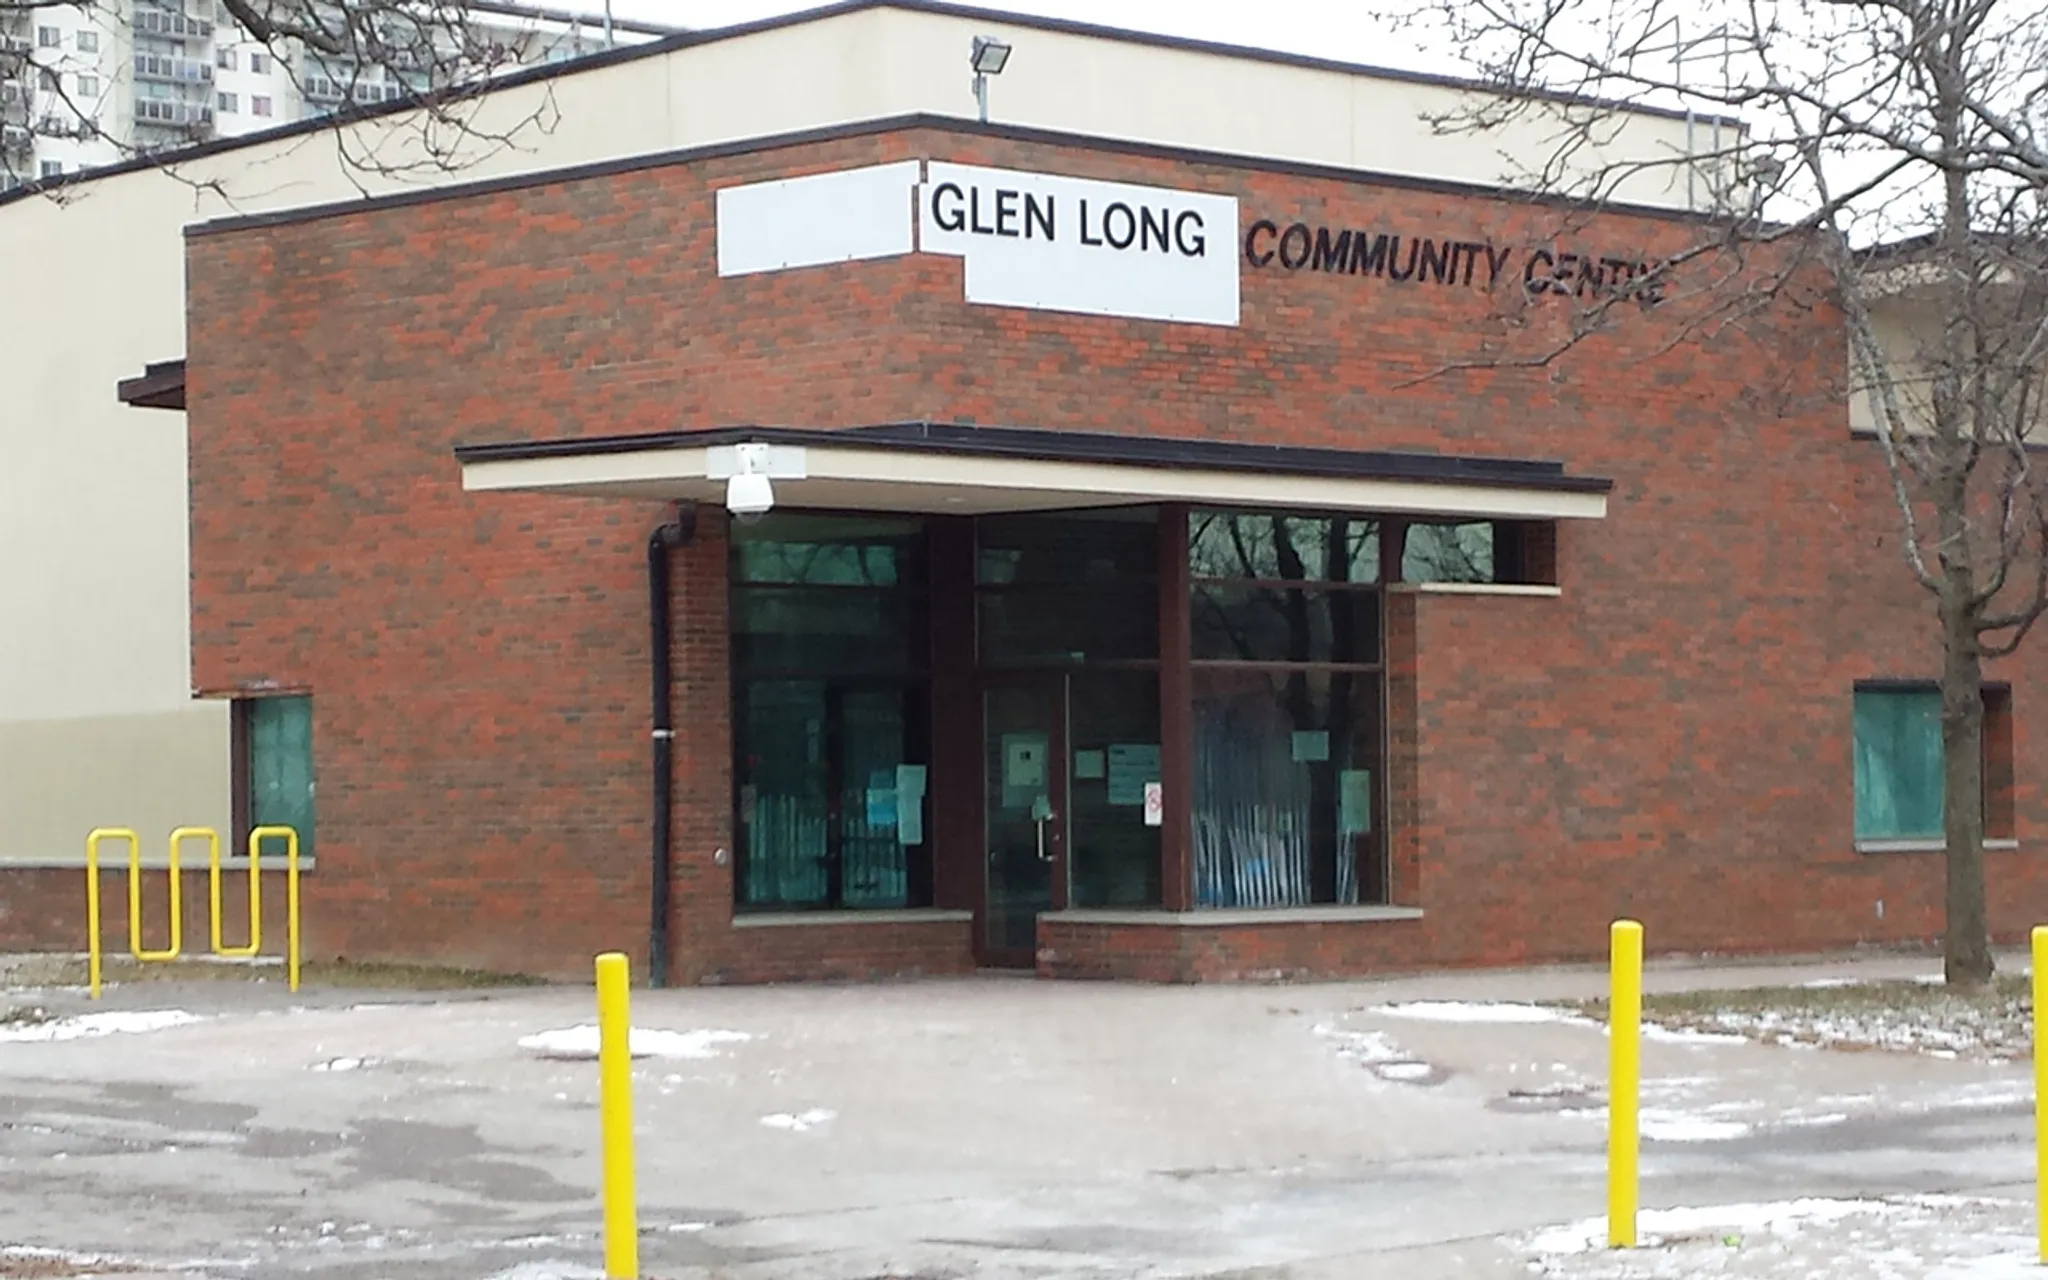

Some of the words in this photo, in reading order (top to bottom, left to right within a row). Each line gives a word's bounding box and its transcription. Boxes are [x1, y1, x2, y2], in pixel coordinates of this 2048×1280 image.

[932, 182, 1055, 241] GLEN
[1080, 199, 1205, 257] LONG
[1245, 219, 1511, 287] COMMUNITY
